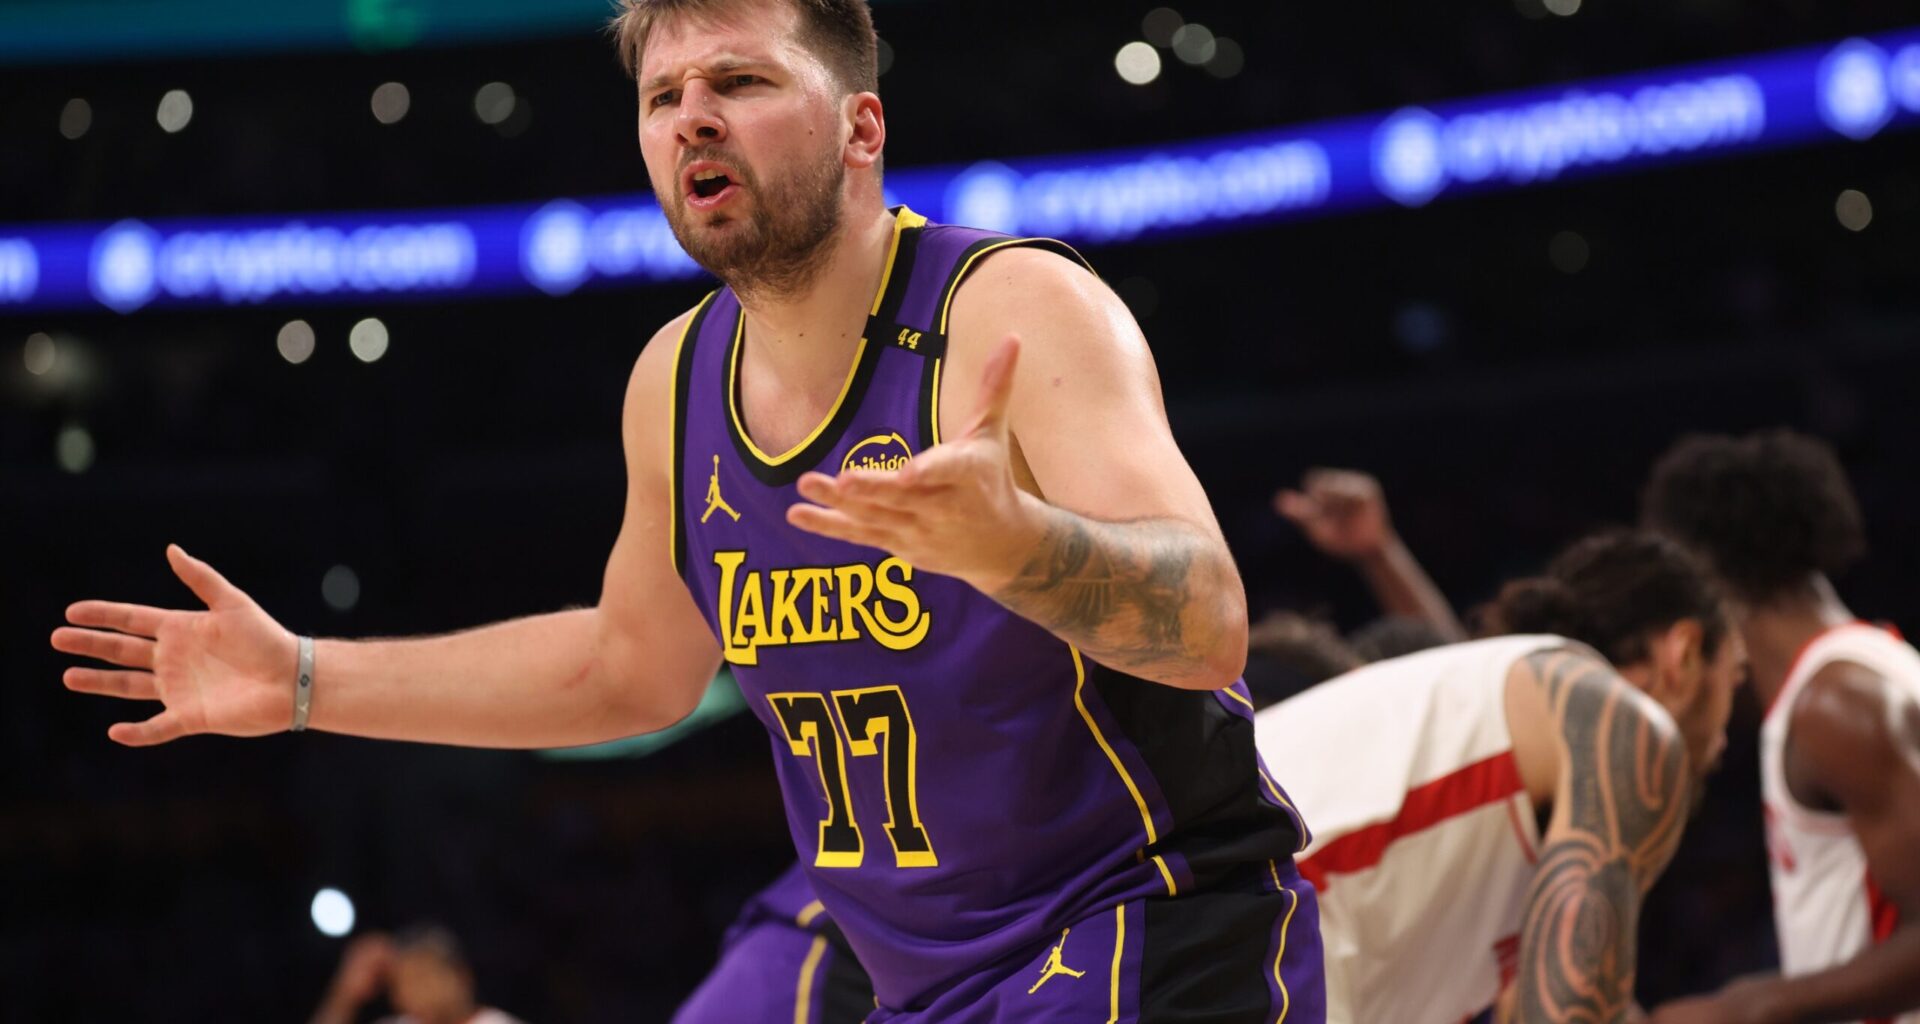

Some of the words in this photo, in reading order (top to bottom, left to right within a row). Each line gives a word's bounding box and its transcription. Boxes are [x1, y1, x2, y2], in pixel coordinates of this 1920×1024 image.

[898, 328, 921, 349] 44
[714, 551, 931, 666] LAKERS
[765, 685, 939, 868] 77
